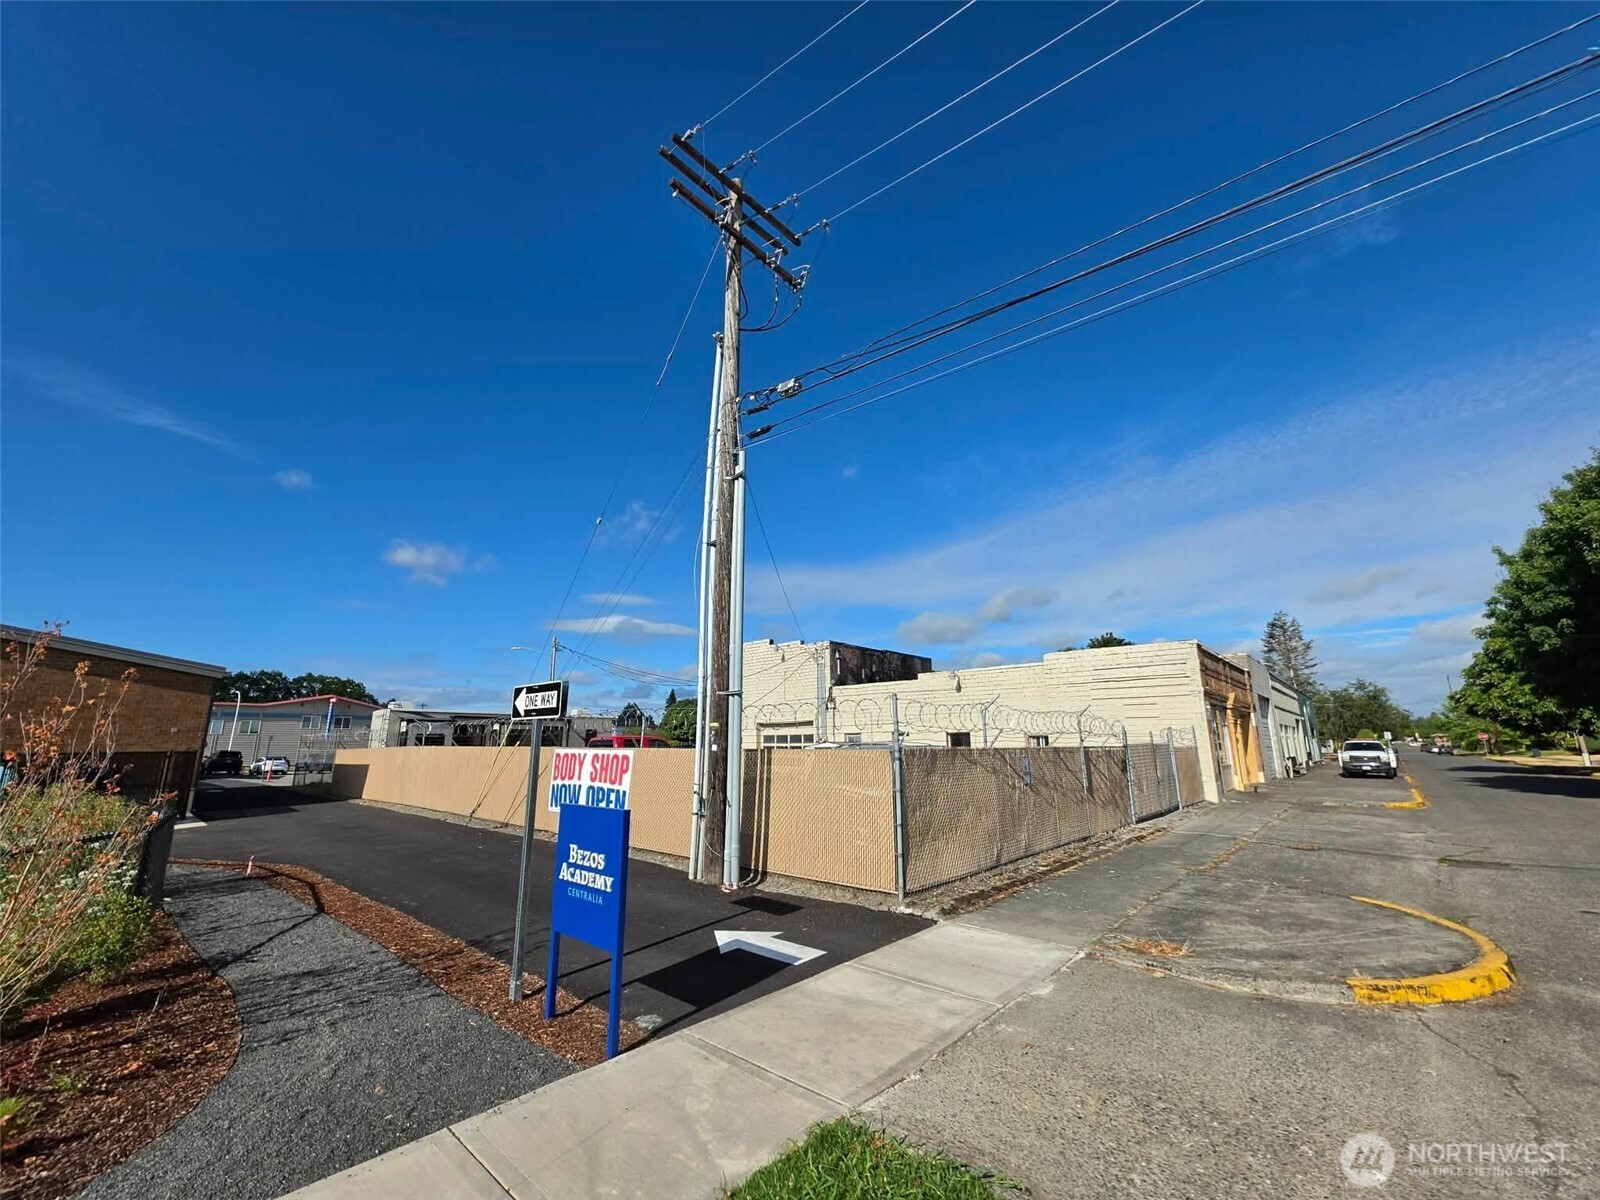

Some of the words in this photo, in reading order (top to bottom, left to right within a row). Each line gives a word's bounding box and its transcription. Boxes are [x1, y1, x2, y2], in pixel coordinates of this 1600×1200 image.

[524, 694, 539, 708] ONE
[540, 692, 556, 707] WAY
[553, 752, 588, 781] BODY
[589, 753, 630, 786] SHOP
[550, 783, 582, 808] NOW
[585, 785, 627, 810] OPEN
[567, 887, 603, 905] CENTRALIA
